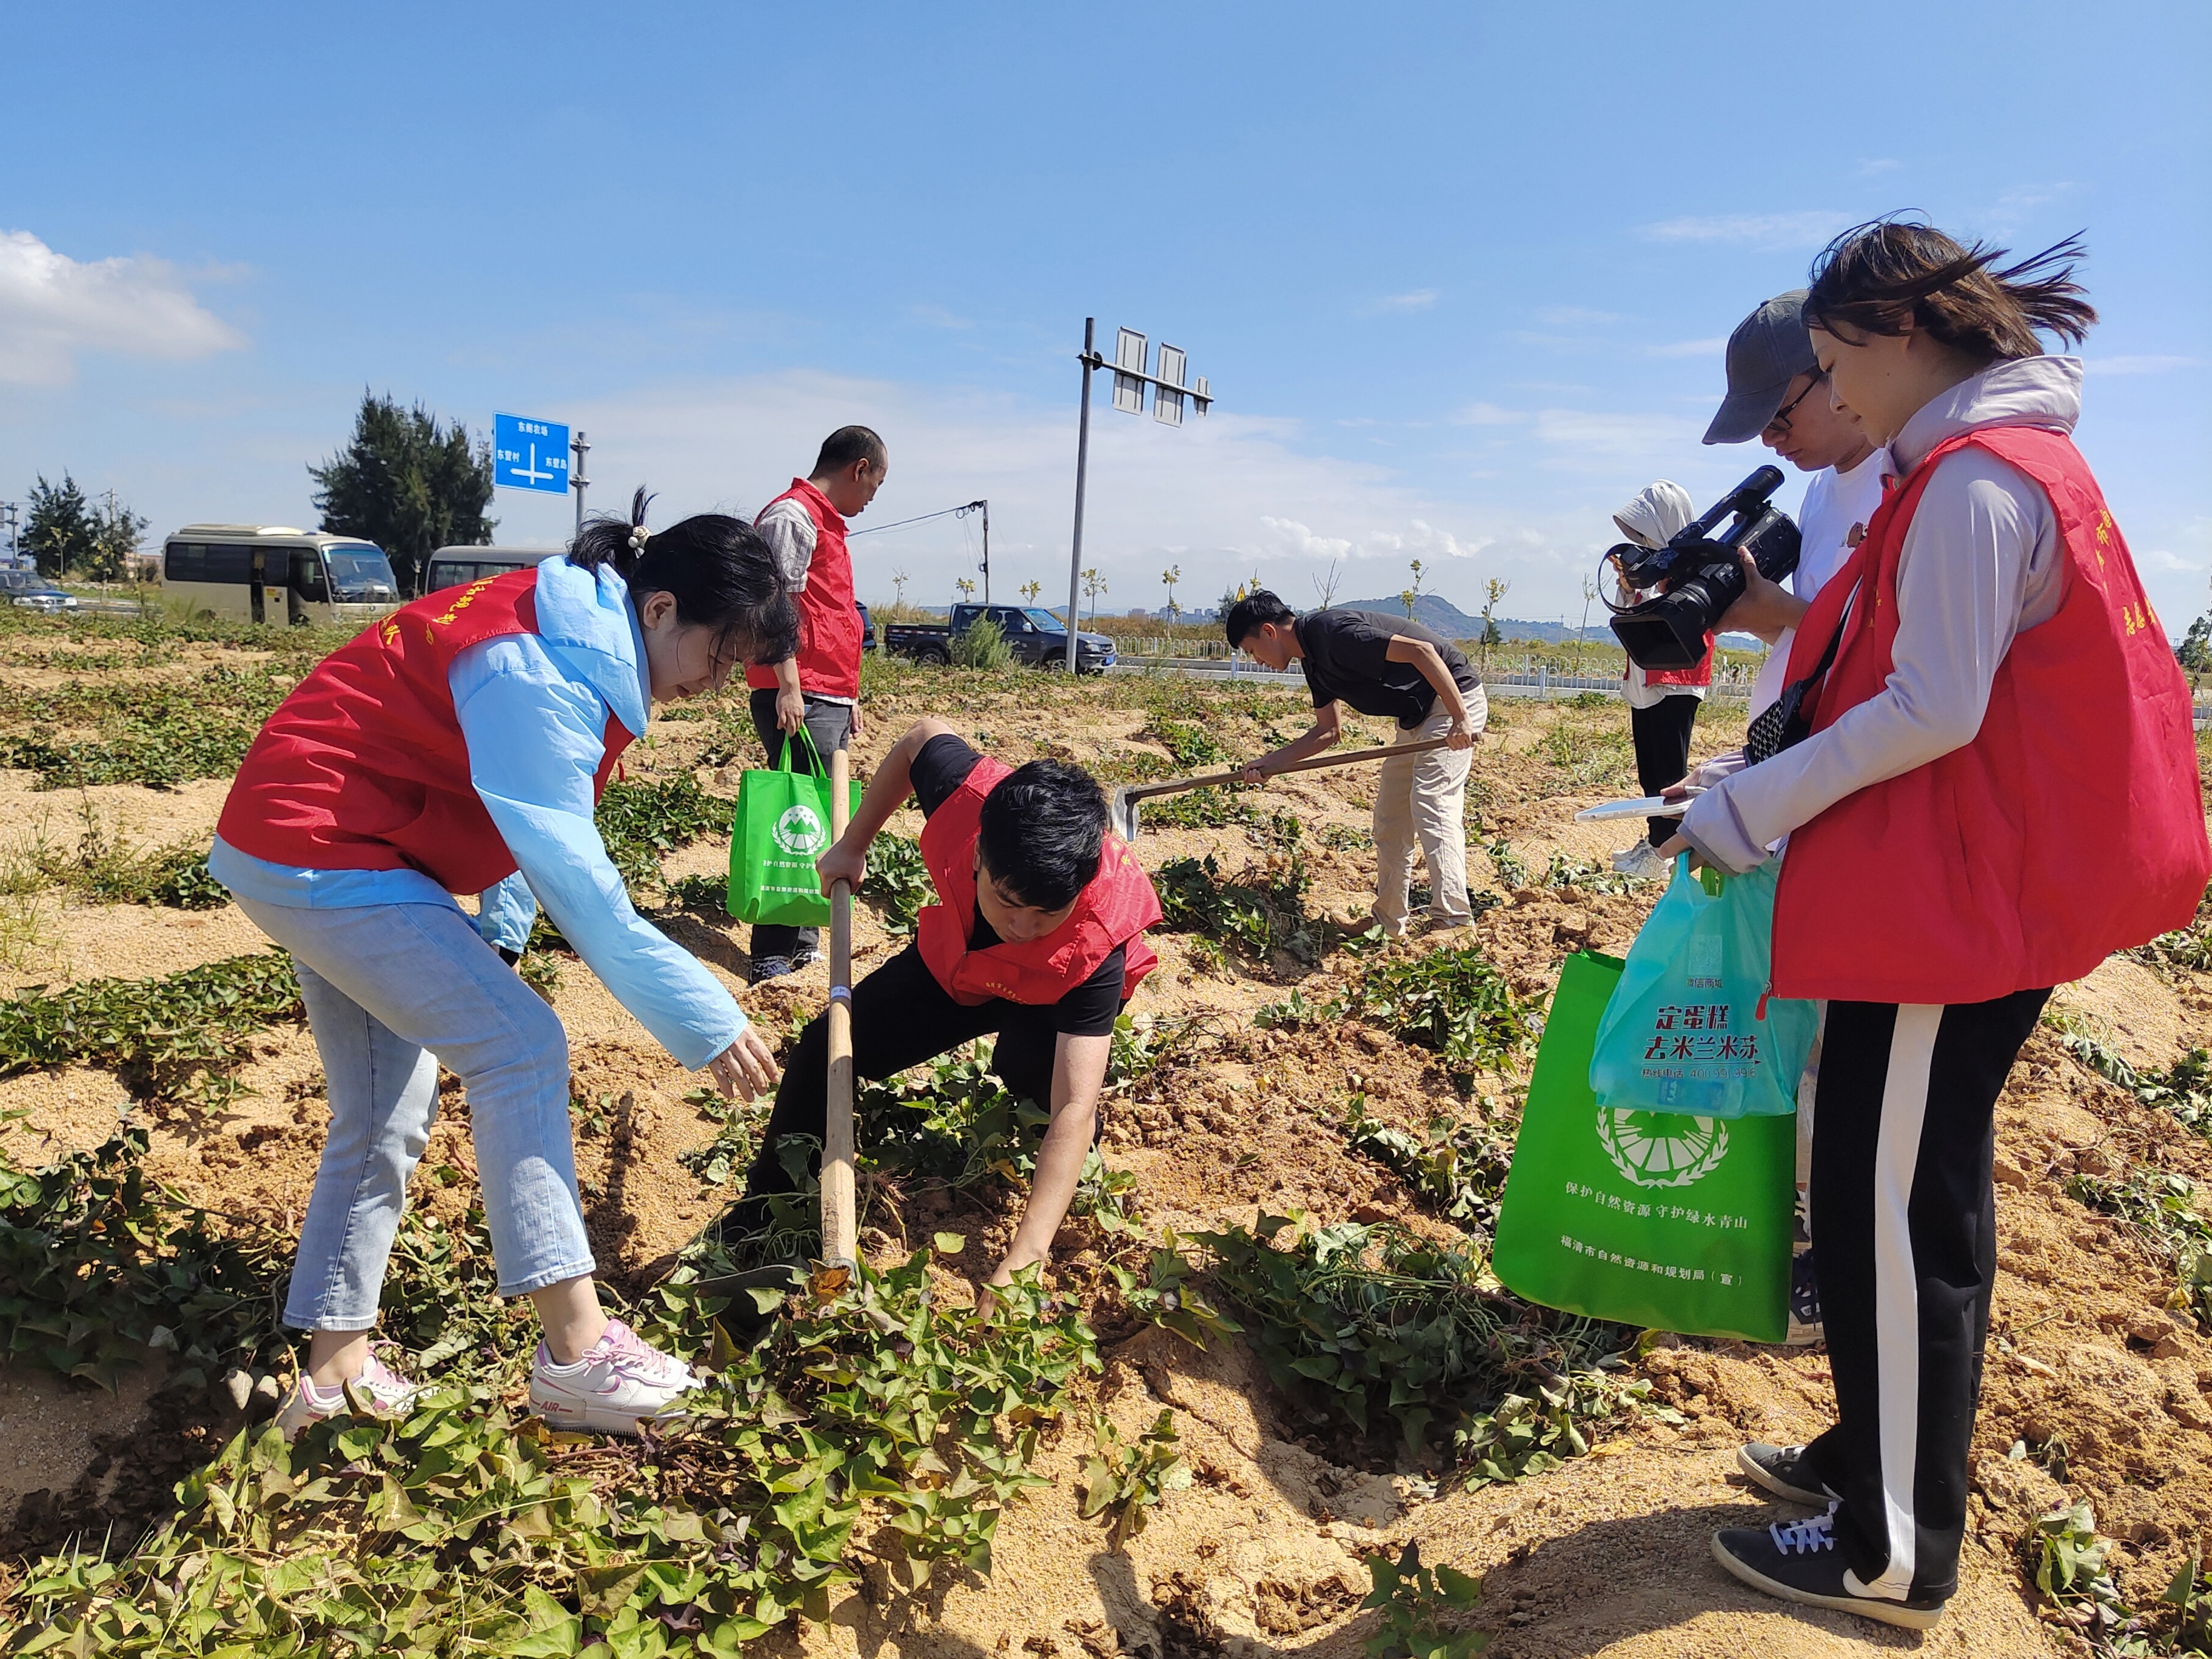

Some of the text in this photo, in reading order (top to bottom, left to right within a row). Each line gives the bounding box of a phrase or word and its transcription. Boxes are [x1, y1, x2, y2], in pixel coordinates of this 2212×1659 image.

[1655, 1005, 1729, 1030] 定蛋糕
[1644, 1034, 1758, 1060] 去米兰米苏
[1642, 1068, 1683, 1079] 热线电话
[1565, 1181, 1748, 1229] 保护自然资源 守护绿水青山
[540, 1401, 559, 1412] AIR
